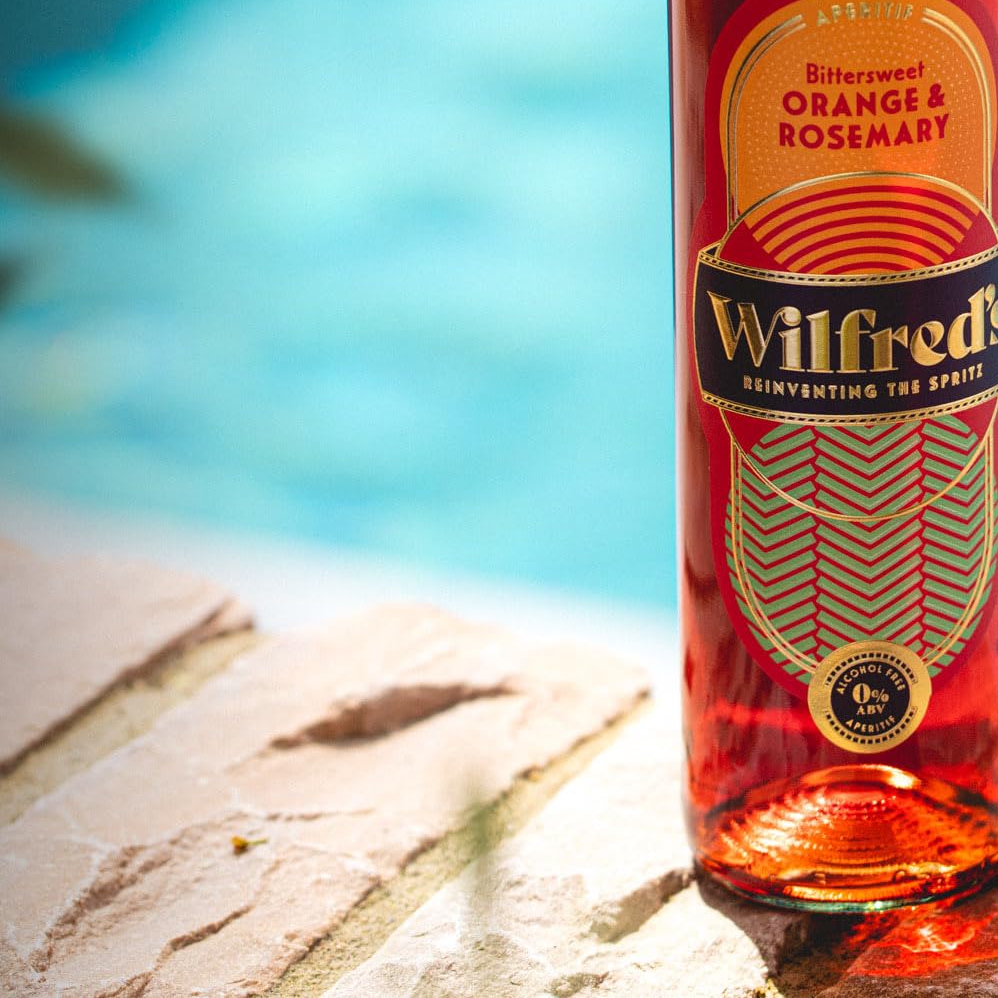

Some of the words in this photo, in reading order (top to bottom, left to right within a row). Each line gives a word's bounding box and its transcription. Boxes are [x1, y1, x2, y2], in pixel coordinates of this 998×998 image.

[806, 60, 925, 85] Bittersweet
[782, 87, 919, 117] ORANGE
[927, 83, 945, 109] &
[779, 113, 949, 150] ROSEMARY
[743, 375, 878, 399] REINVENTING
[886, 379, 921, 397] THE
[928, 362, 984, 393] SPRITZ
[836, 664, 883, 695] ALCOHOL
[885, 668, 906, 692] FREE
[852, 682, 890, 705] 0%
[845, 714, 897, 733] APERITIF
[856, 704, 886, 715] ABV
